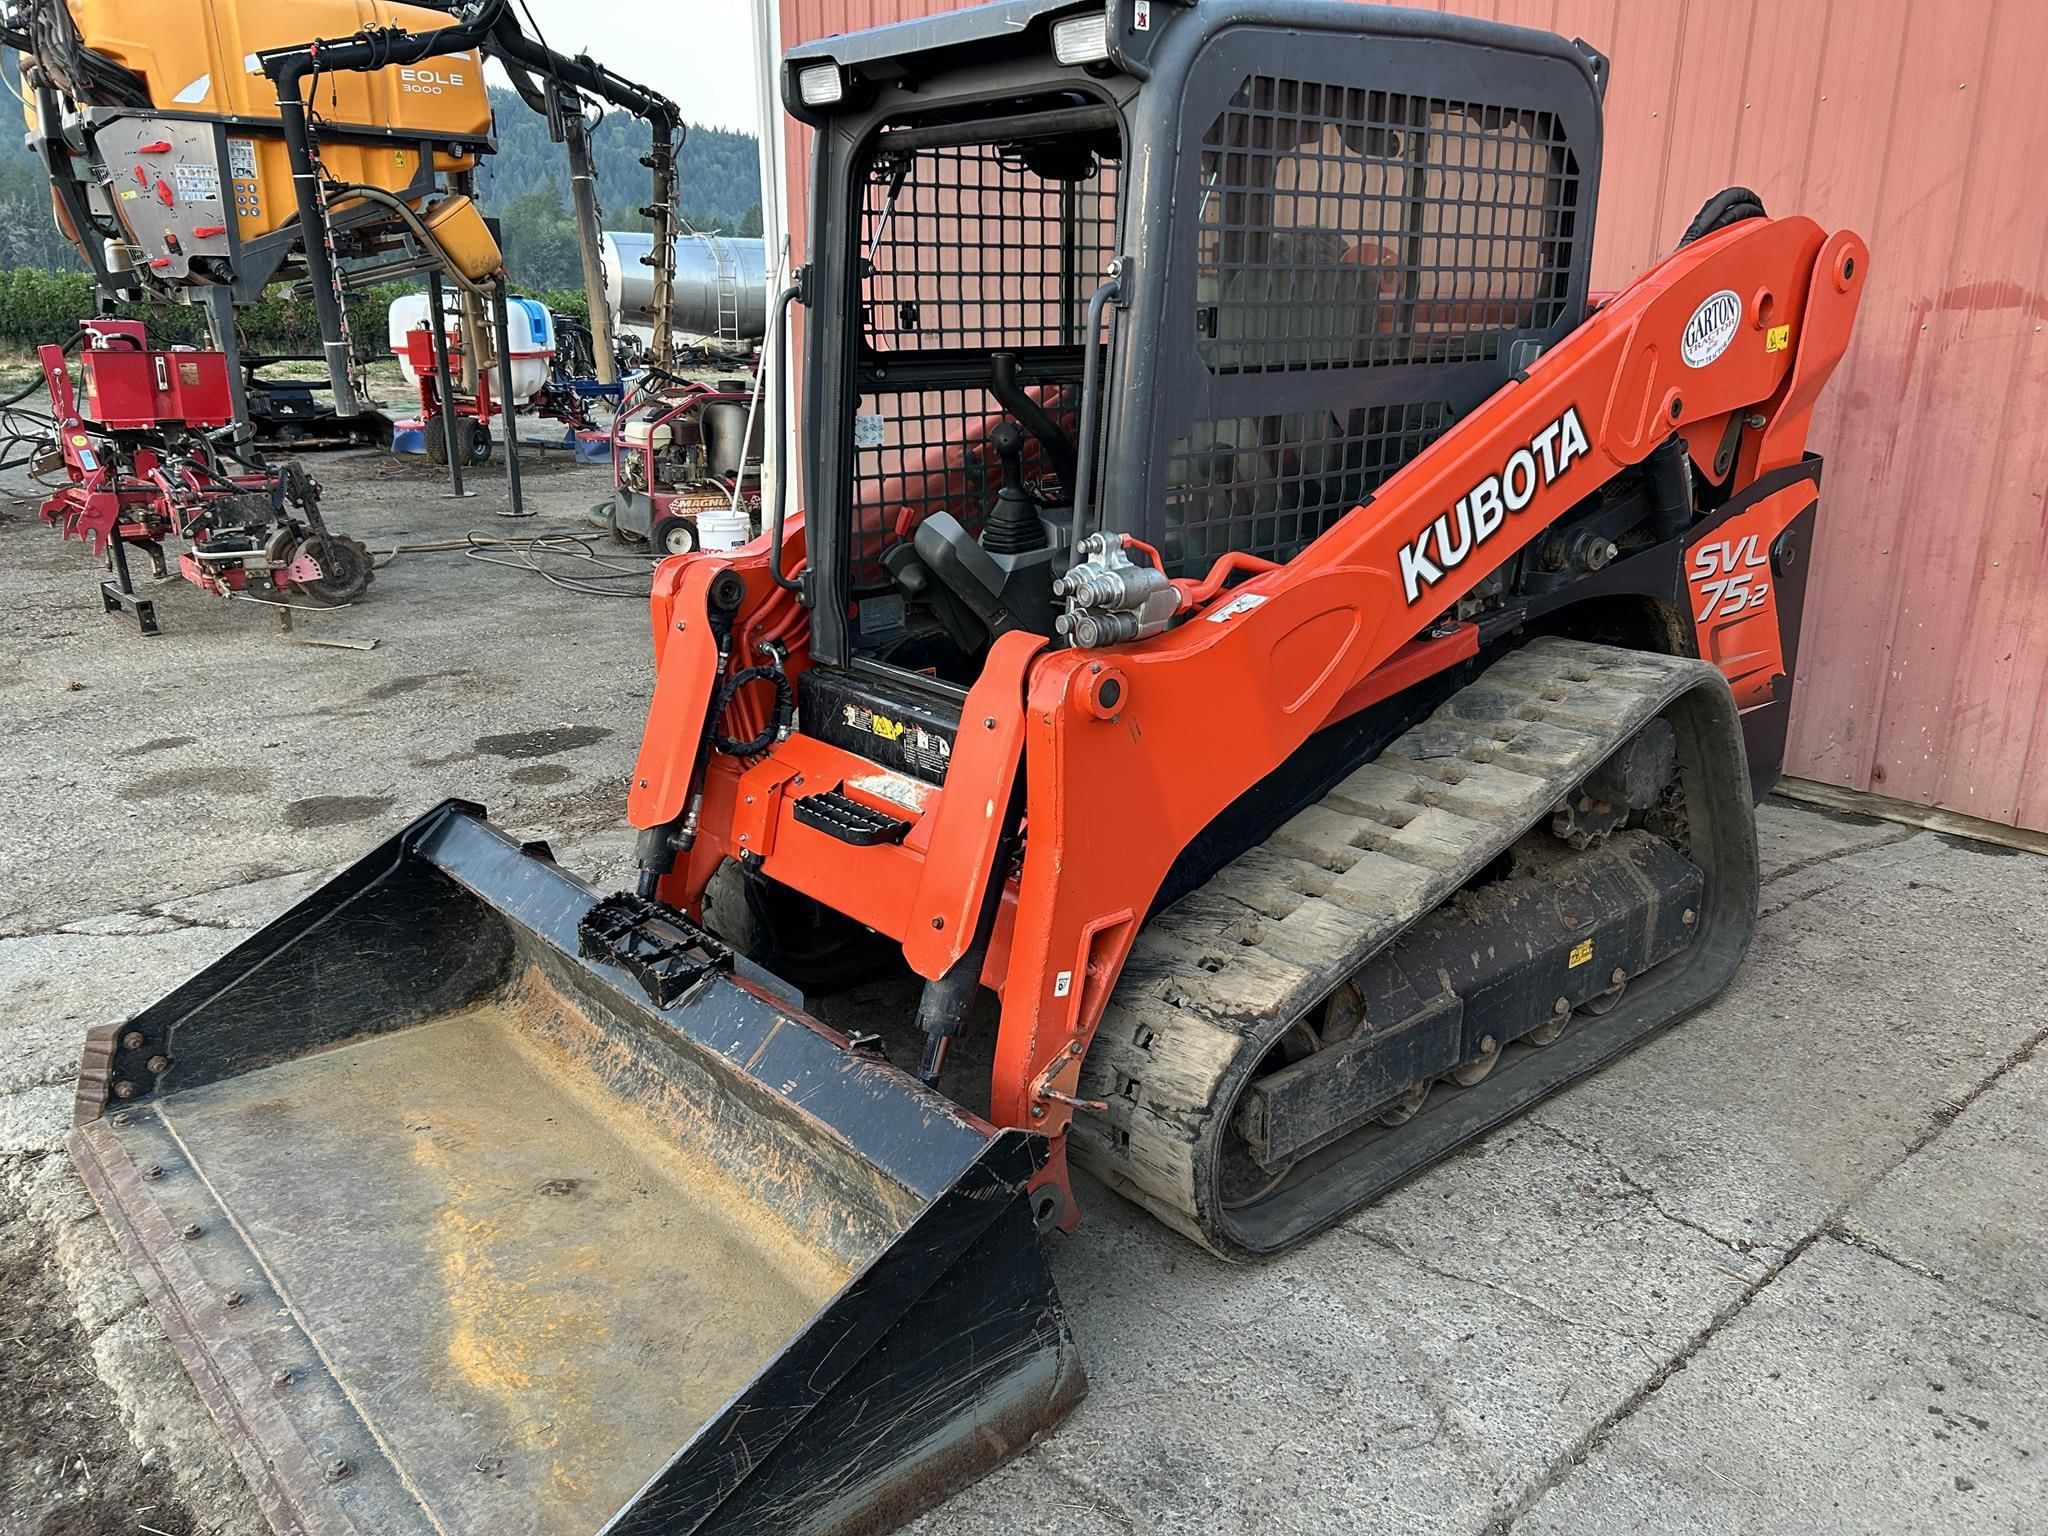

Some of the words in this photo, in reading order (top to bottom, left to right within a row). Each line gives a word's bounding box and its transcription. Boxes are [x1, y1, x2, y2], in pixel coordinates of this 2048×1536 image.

[401, 69, 464, 86] EOLE
[402, 84, 442, 95] 3000
[1685, 298, 1735, 348] GARTON
[1687, 318, 1735, 355] TRACTOR
[1397, 406, 1590, 605] KUBOTA
[1689, 534, 1768, 582] SVL
[1697, 572, 1769, 623] 75-2
